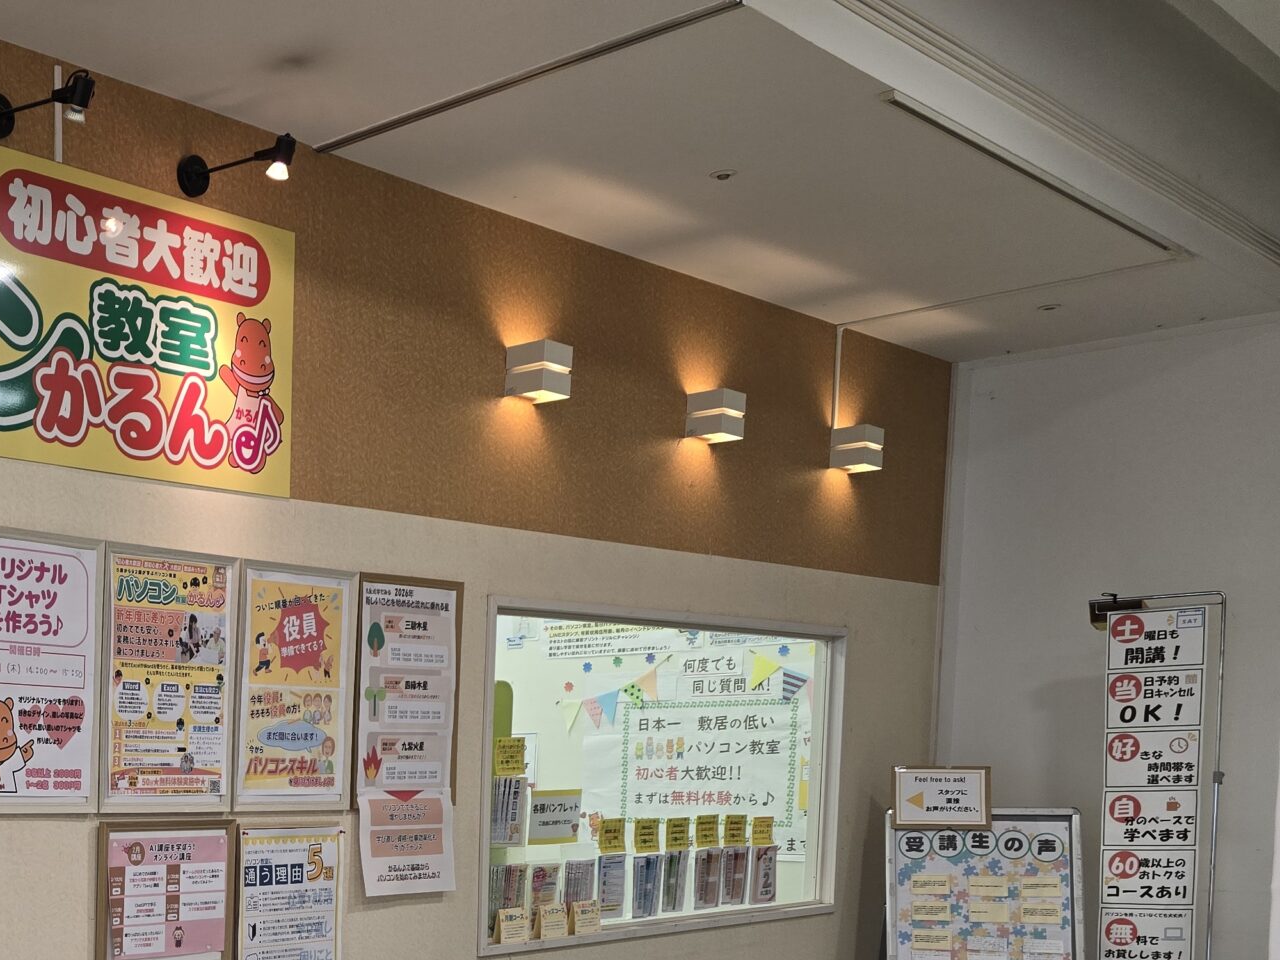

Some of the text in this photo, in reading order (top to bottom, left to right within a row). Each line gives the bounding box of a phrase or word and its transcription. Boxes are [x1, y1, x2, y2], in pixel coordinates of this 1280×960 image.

[8, 176, 259, 299] 初心者大歓迎
[91, 279, 218, 380] 教室
[117, 576, 178, 606] パソコン
[395, 588, 414, 598] 2026年
[283, 612, 317, 642] 役員
[683, 657, 736, 673] 何度でも
[692, 678, 747, 694] 同じ質問
[637, 714, 776, 733] 日本一 敷居の低い
[249, 745, 264, 754] 今から
[687, 739, 781, 756] パソコン教室
[246, 755, 319, 775] パソコンスキル
[1147, 762, 1196, 772] 時間帯を
[1147, 774, 1195, 784] 選べます
[533, 803, 579, 814] 各種パンフレット
[1124, 828, 1191, 842] 学べます
[905, 832, 1057, 856] 受講生の声
[153, 853, 192, 861] オンライン講座
[245, 864, 304, 887] 通う理由
[1138, 870, 1186, 880] おトクな
[1107, 885, 1187, 899] コースあり
